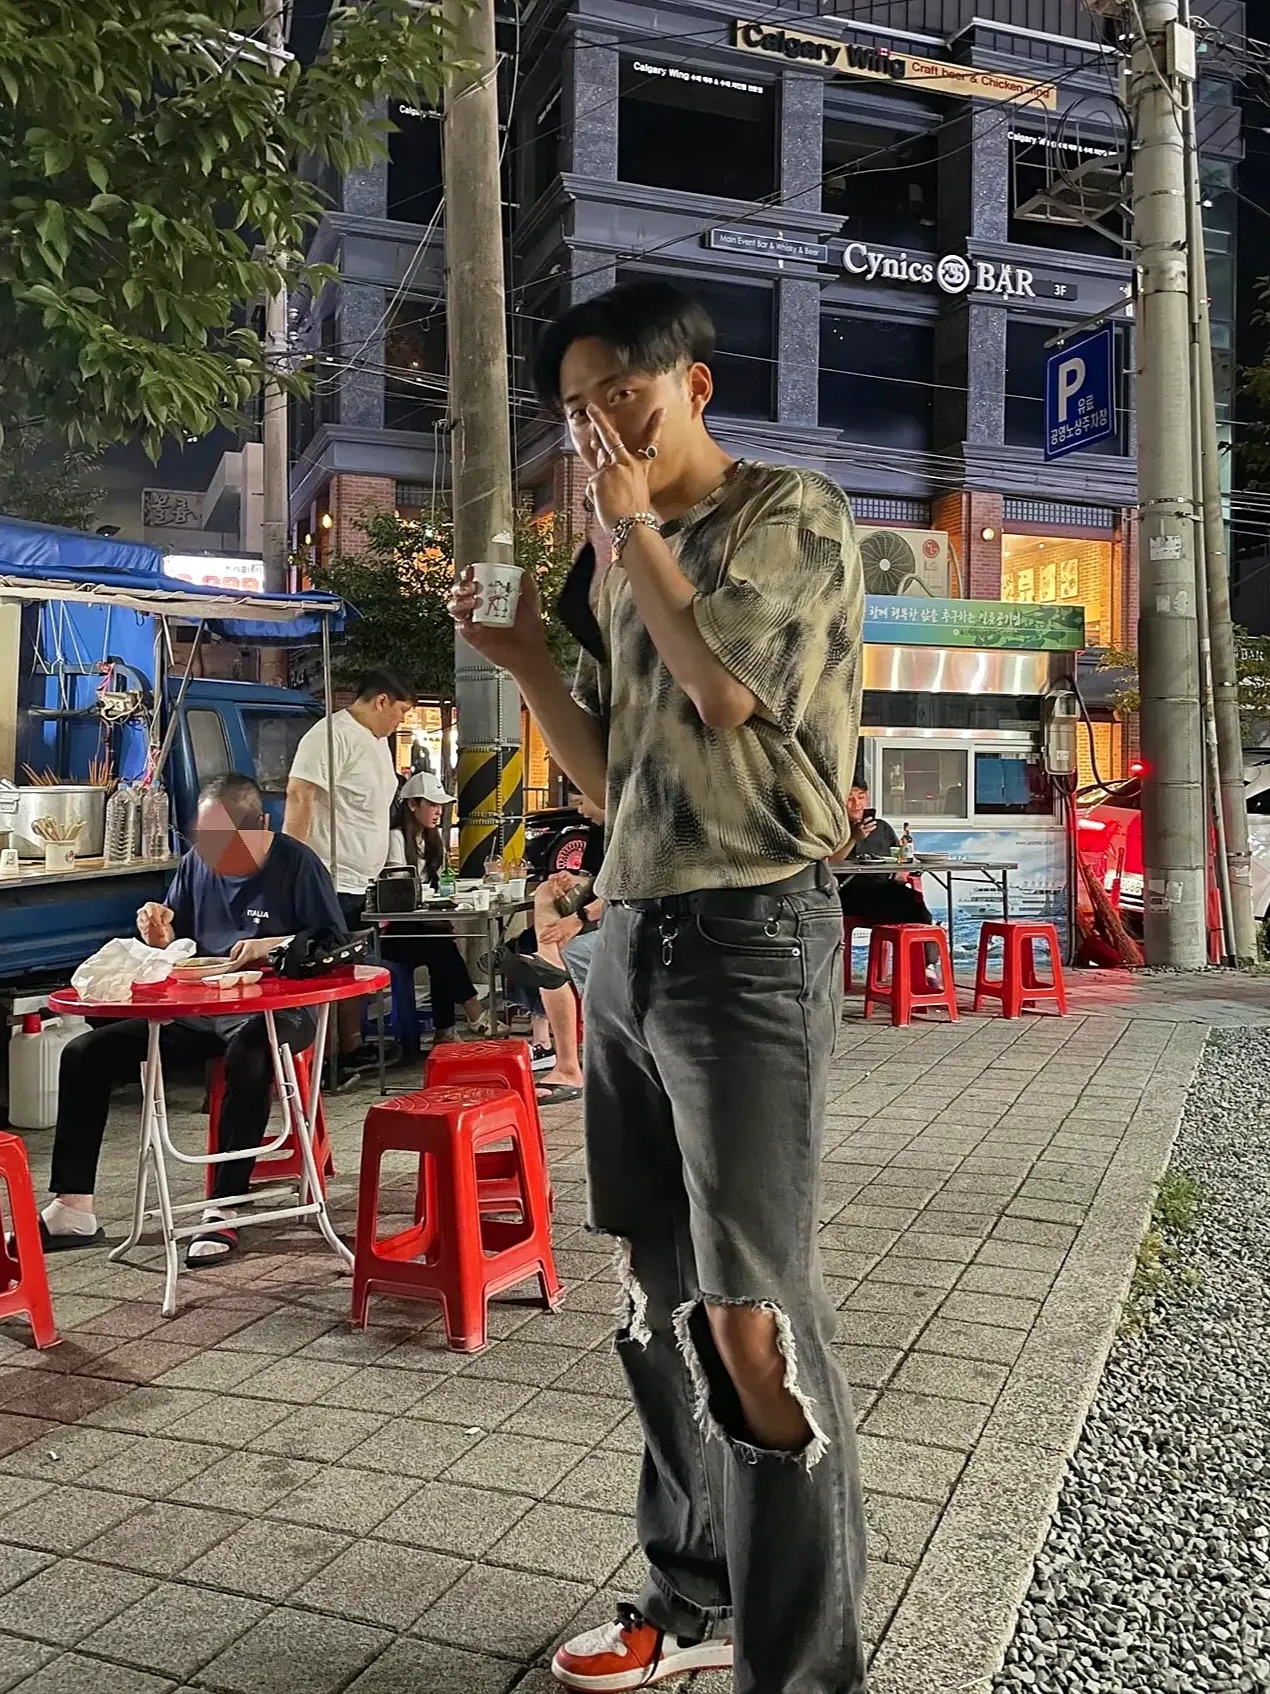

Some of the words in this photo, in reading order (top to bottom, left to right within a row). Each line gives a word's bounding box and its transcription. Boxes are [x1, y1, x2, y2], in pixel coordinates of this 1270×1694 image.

[742, 24, 841, 66] Calgary
[845, 44, 905, 79] Wing
[633, 61, 667, 76] Calgary
[669, 68, 690, 81] Wing
[912, 61, 938, 76] Craft
[942, 69, 965, 82] beer
[970, 74, 978, 84] &
[981, 76, 1023, 92] Chicken
[720, 234, 736, 243] Main
[738, 237, 755, 247] Event
[757, 240, 767, 248] Bar
[776, 243, 797, 254] Whisky
[798, 246, 803, 254] &
[805, 247, 819, 256] Beer
[843, 243, 933, 283] Cynics
[974, 262, 1036, 298] BAR
[1054, 284, 1067, 296] 3F
[1058, 357, 1086, 423] P
[1078, 394, 1095, 415] 유료
[1051, 408, 1108, 445] 공영노상주차장
[924, 561, 937, 571] LG
[891, 605, 918, 622] 행복한
[920, 607, 938, 623] 삶을
[941, 608, 975, 624] 추구하는
